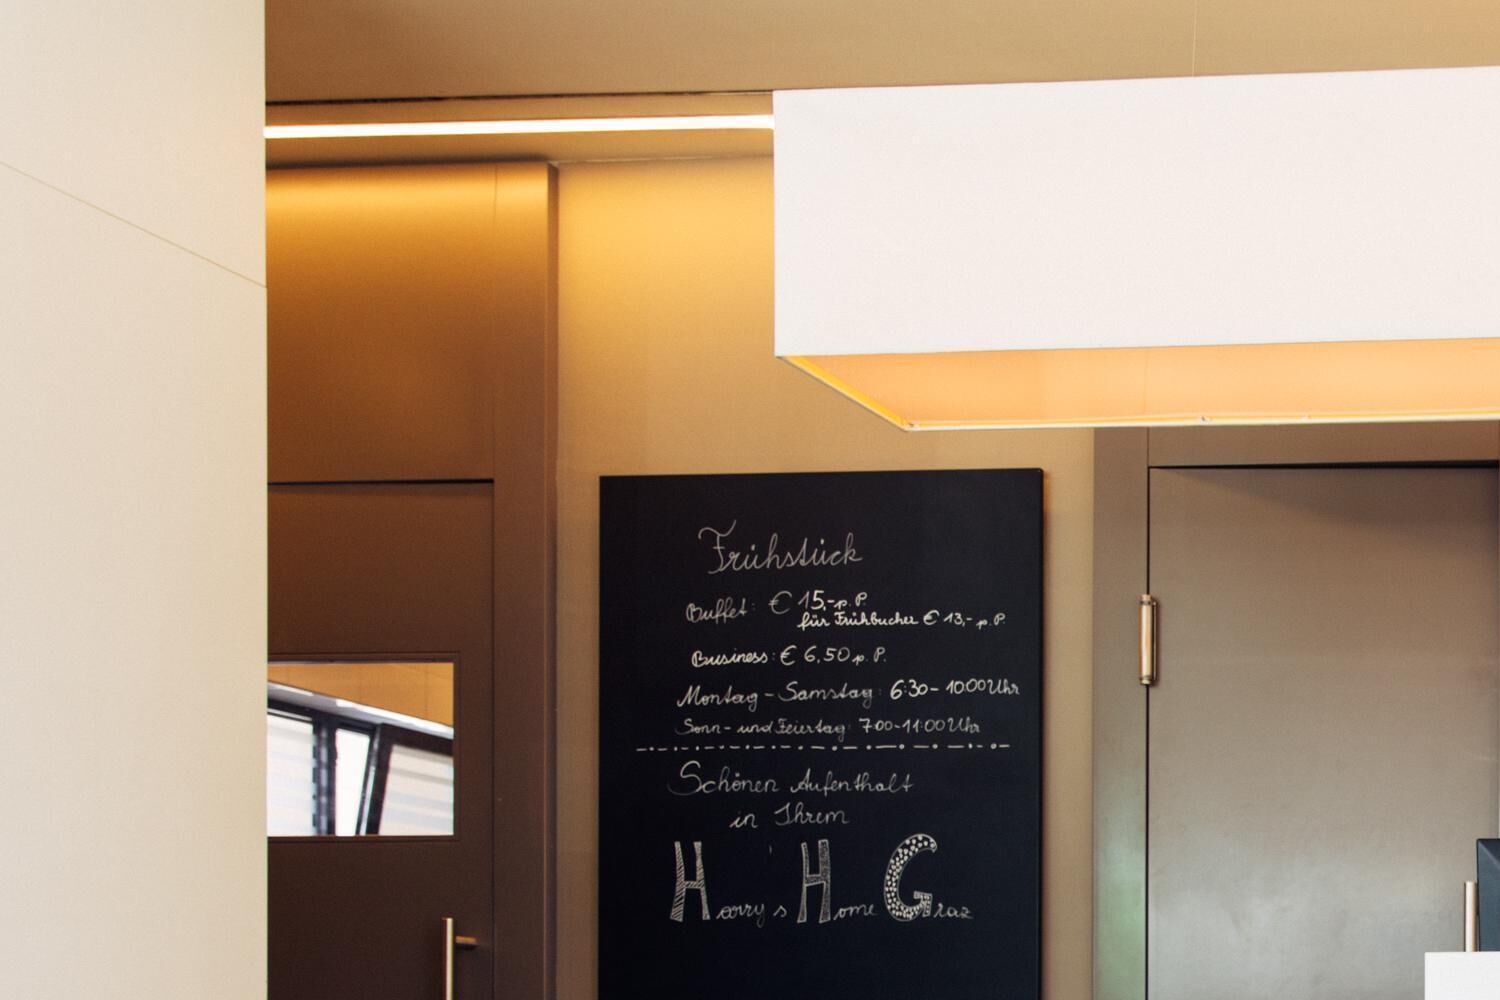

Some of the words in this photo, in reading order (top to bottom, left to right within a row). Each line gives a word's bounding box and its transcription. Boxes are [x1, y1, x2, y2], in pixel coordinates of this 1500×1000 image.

[698, 519, 863, 575] Frühstück
[768, 590, 793, 615] €
[797, 612, 830, 631] für
[833, 611, 920, 627] Frühbucher
[923, 609, 940, 626] €
[780, 645, 797, 665] €
[677, 685, 758, 713] Montag
[986, 679, 1021, 696] Uhr
[737, 721, 773, 734] und
[947, 716, 981, 734] Uhr
[667, 760, 779, 796] Schönen
[790, 768, 914, 797] Aufenthalt
[729, 812, 759, 829] in
[774, 802, 849, 826] Ihrem
[797, 839, 878, 924] Home
[884, 834, 974, 921] Graz
